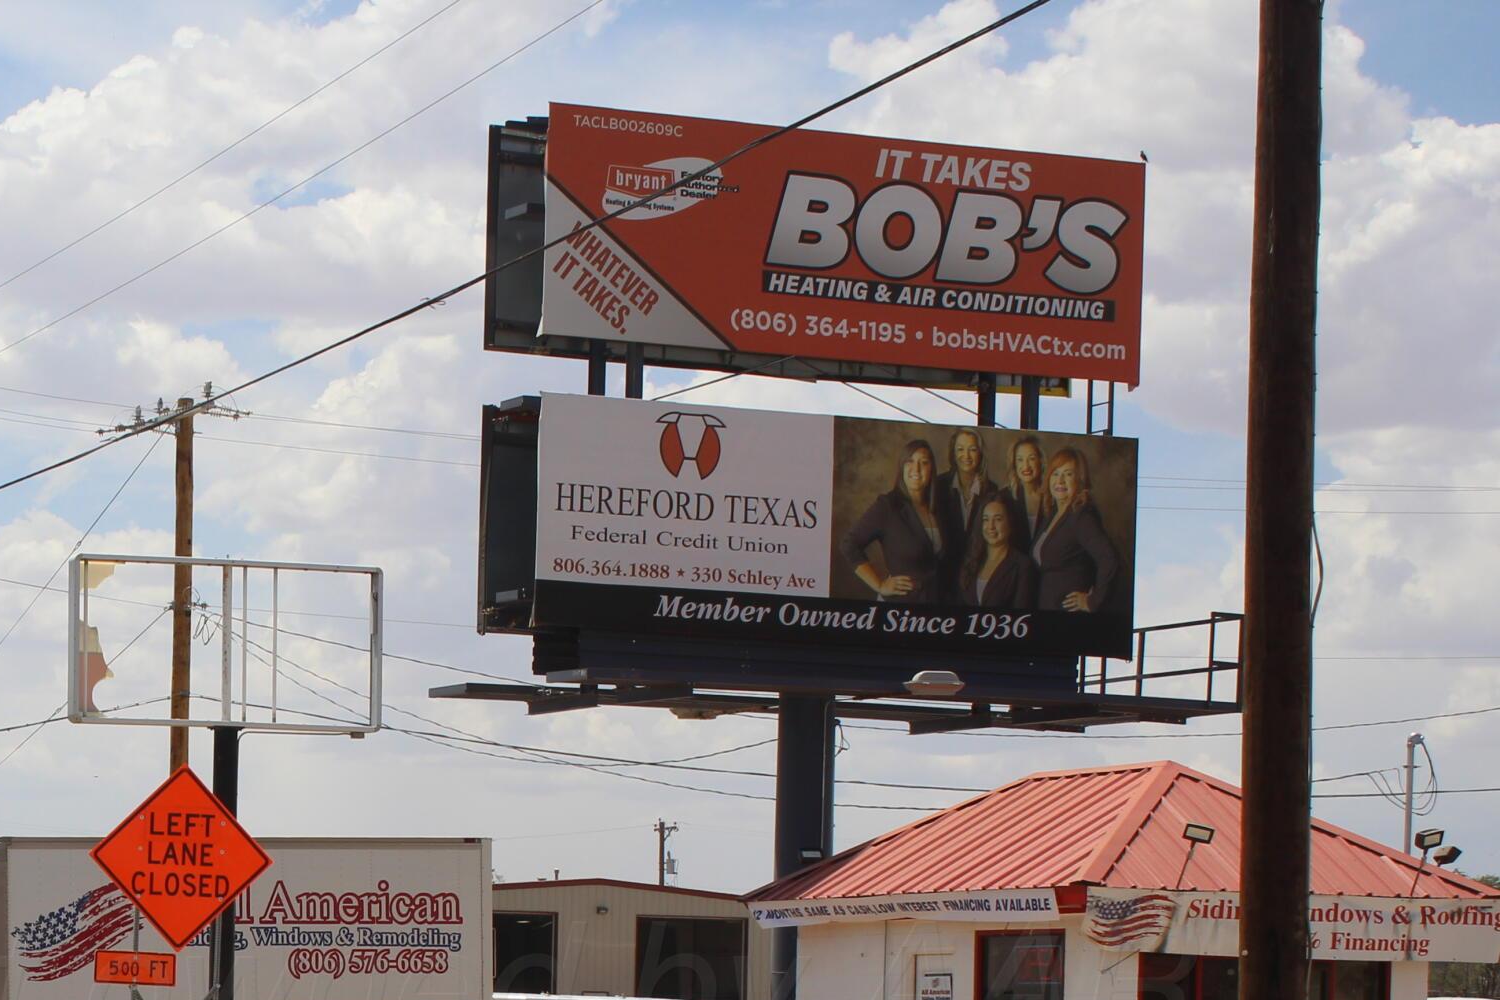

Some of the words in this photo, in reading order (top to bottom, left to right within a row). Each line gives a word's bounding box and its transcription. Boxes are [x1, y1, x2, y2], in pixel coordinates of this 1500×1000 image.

[573, 114, 683, 137] TACLB002609C
[615, 169, 667, 191] bryant
[680, 171, 724, 184] Fatory
[876, 148, 913, 180] IT
[920, 152, 1032, 192] TAKES
[680, 189, 719, 200] Dealer
[763, 170, 1130, 294] BOB'S
[552, 251, 580, 280] IT
[566, 220, 660, 316] WHATEVER
[572, 267, 631, 335] TAKES.
[768, 273, 869, 301] HEATING
[876, 284, 891, 302] &
[899, 285, 935, 308] AIR
[942, 289, 1105, 320] CONDITIONING
[730, 308, 798, 337] (806)
[805, 314, 907, 344] 364-1195
[932, 326, 1126, 361] bobsHVACtx.com
[555, 482, 714, 522] HEREFORD
[724, 495, 818, 530] TEXAS
[570, 525, 647, 546] Federal
[656, 530, 718, 550] Credit
[728, 535, 789, 554] Union
[553, 557, 670, 581] 806.364.1888
[691, 566, 722, 584] 330
[728, 568, 780, 591] Schley
[785, 573, 816, 590] Ave
[654, 595, 770, 625] Member
[778, 602, 876, 632] Owned
[884, 607, 956, 636] Since
[964, 614, 1031, 640] 1936
[150, 812, 215, 837] LEFT
[148, 841, 213, 867] LANE
[131, 871, 230, 898] CLOSED
[260, 880, 463, 925] American
[765, 907, 803, 920] MONTHS
[804, 906, 831, 917] SAME
[834, 905, 845, 916] AS
[899, 900, 941, 912] INTEREST
[943, 899, 991, 912] FINANCING
[995, 898, 1052, 912] AVAILABLE
[1188, 899, 1241, 920] Sidi
[1310, 902, 1383, 925] ndows
[1391, 905, 1411, 925] &
[250, 927, 332, 947] Windows
[336, 928, 354, 947] &
[357, 927, 461, 951] Remodeling
[1330, 932, 1430, 956] Financing
[109, 960, 140, 977] 500
[150, 961, 169, 978] FT
[288, 949, 345, 979] (806)
[349, 949, 448, 974] 576-6658
